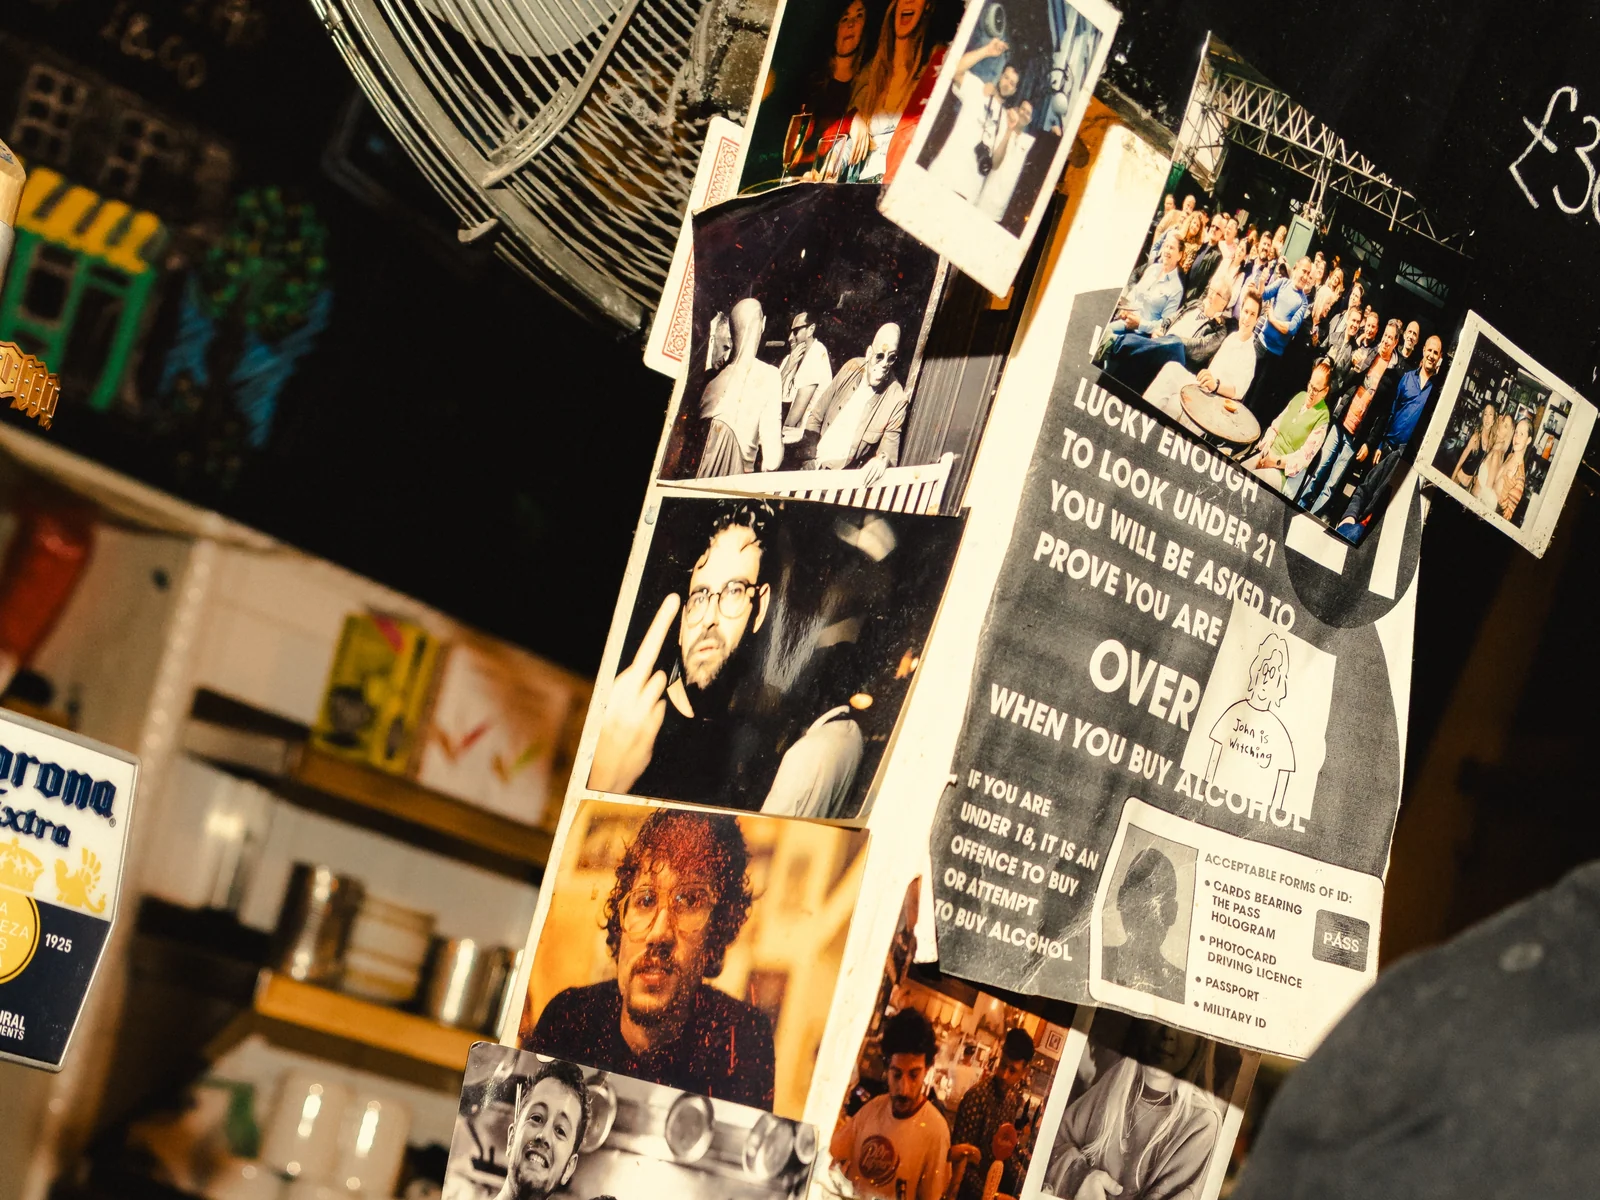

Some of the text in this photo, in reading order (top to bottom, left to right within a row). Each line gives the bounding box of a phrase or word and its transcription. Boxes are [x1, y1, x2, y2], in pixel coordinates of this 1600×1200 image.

[1509, 85, 1600, 226] £3
[1073, 377, 1259, 503] LUCKY ENOUGH
[1061, 428, 1276, 568] TO LOOK UNDER 21
[1051, 479, 1295, 633] YOU WILL BE ASKED TO
[1033, 531, 1223, 646] PROVE YOU ARE
[1089, 639, 1201, 732] OVER
[1232, 718, 1269, 744] John is
[990, 683, 1305, 833] WHEN YOU BUY ALCOHOL
[0, 788, 71, 847] xtra
[967, 768, 1052, 818] IF YOU ARE
[960, 801, 1099, 871] UNDER 18, IT IS AN
[951, 835, 1079, 897] OFFENCE TO BUY
[1204, 853, 1353, 904] ACCEPTABLE FORMS OF ID:
[944, 867, 1039, 916] OR ATTEMPT
[1212, 895, 1261, 919] THE PASS
[1213, 880, 1303, 915] CARDS BEARING
[45, 933, 73, 953] 1925
[935, 899, 1073, 961] TO BUY ALCOHOL
[1208, 935, 1277, 966] PHOTOCARD
[1211, 911, 1276, 940] HOLOGRAM
[1322, 931, 1360, 953] PASS
[1205, 976, 1259, 1002] PASSPORT
[1207, 951, 1303, 989] DRIVING LICENCE
[1203, 1001, 1267, 1029] MILITARY ID
